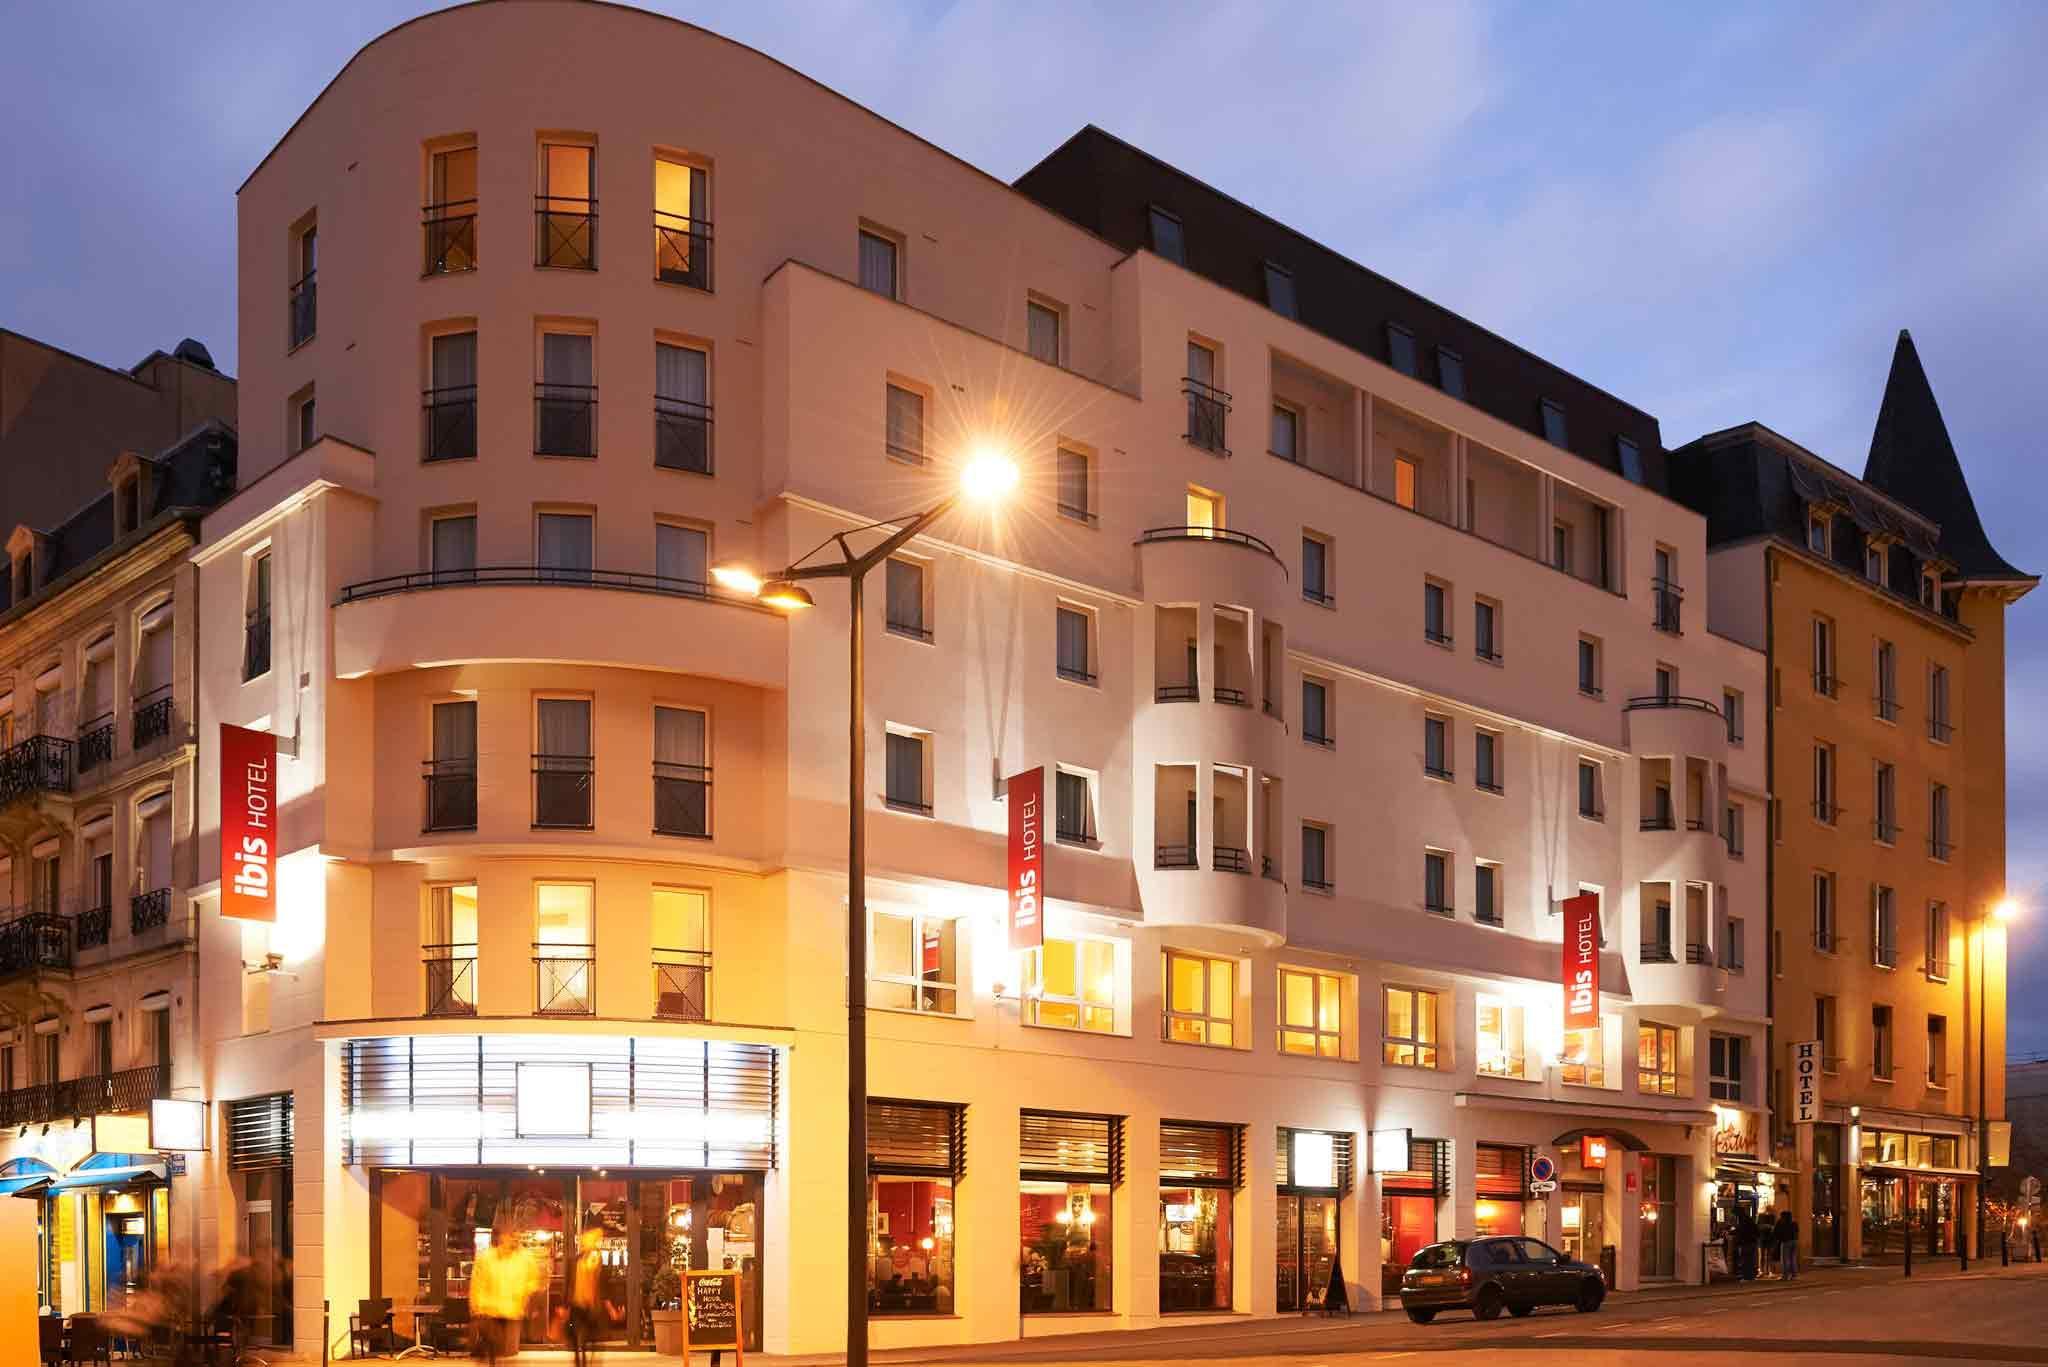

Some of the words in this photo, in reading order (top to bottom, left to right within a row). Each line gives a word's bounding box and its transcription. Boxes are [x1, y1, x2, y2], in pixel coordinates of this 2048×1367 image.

[247, 758, 268, 829] HOTEL
[1023, 792, 1037, 862] HOTEL
[234, 836, 269, 898] ibis
[1015, 868, 1037, 930] ibis
[1578, 911, 1593, 964] HOTEL
[1569, 969, 1593, 1016] ibis
[1798, 1044, 1813, 1120] HOTEL
[697, 1287, 721, 1295] HAPPY
